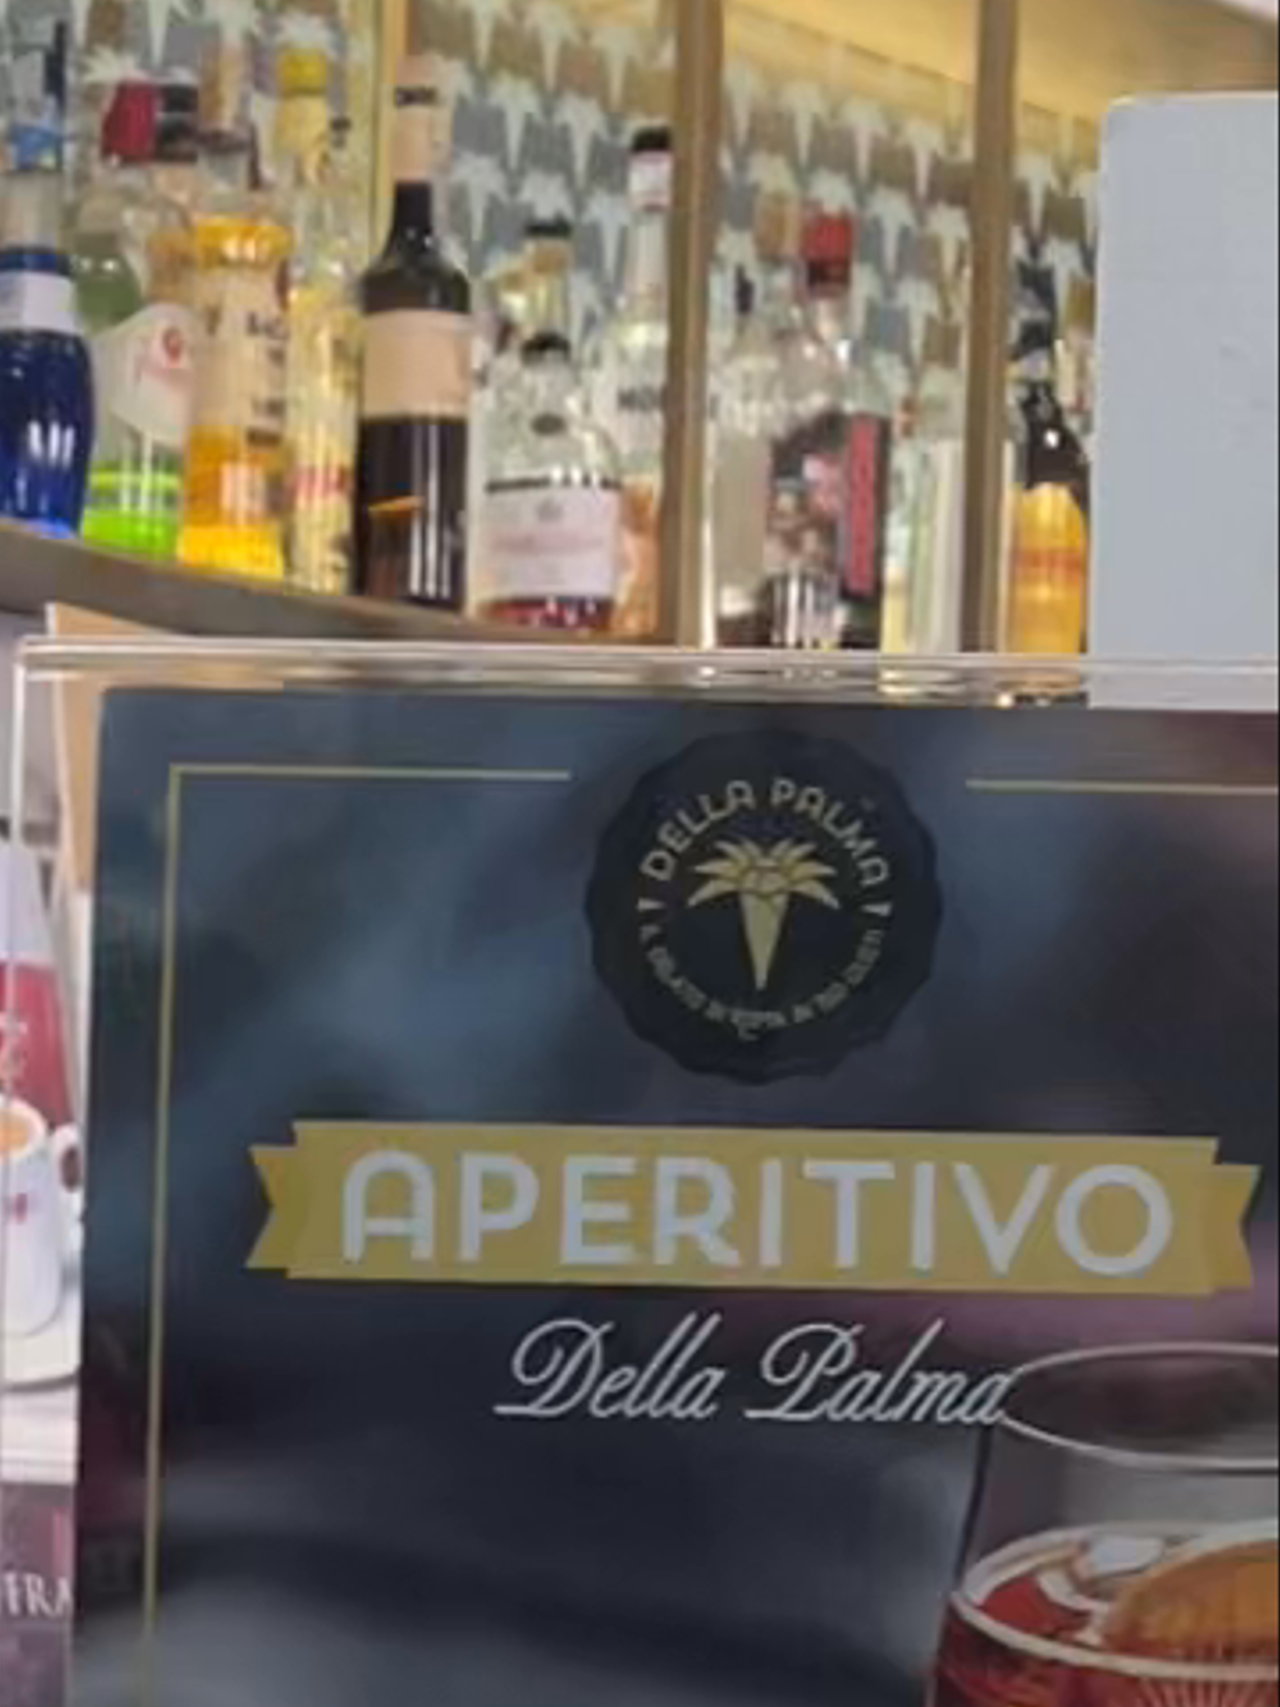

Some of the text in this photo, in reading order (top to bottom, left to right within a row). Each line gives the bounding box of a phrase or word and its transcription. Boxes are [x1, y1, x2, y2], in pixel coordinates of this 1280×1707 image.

[641, 777, 889, 889] DELLA PALMA
[341, 1149, 1175, 1277] APERITIVO
[492, 1311, 1024, 1426] Della Palma
